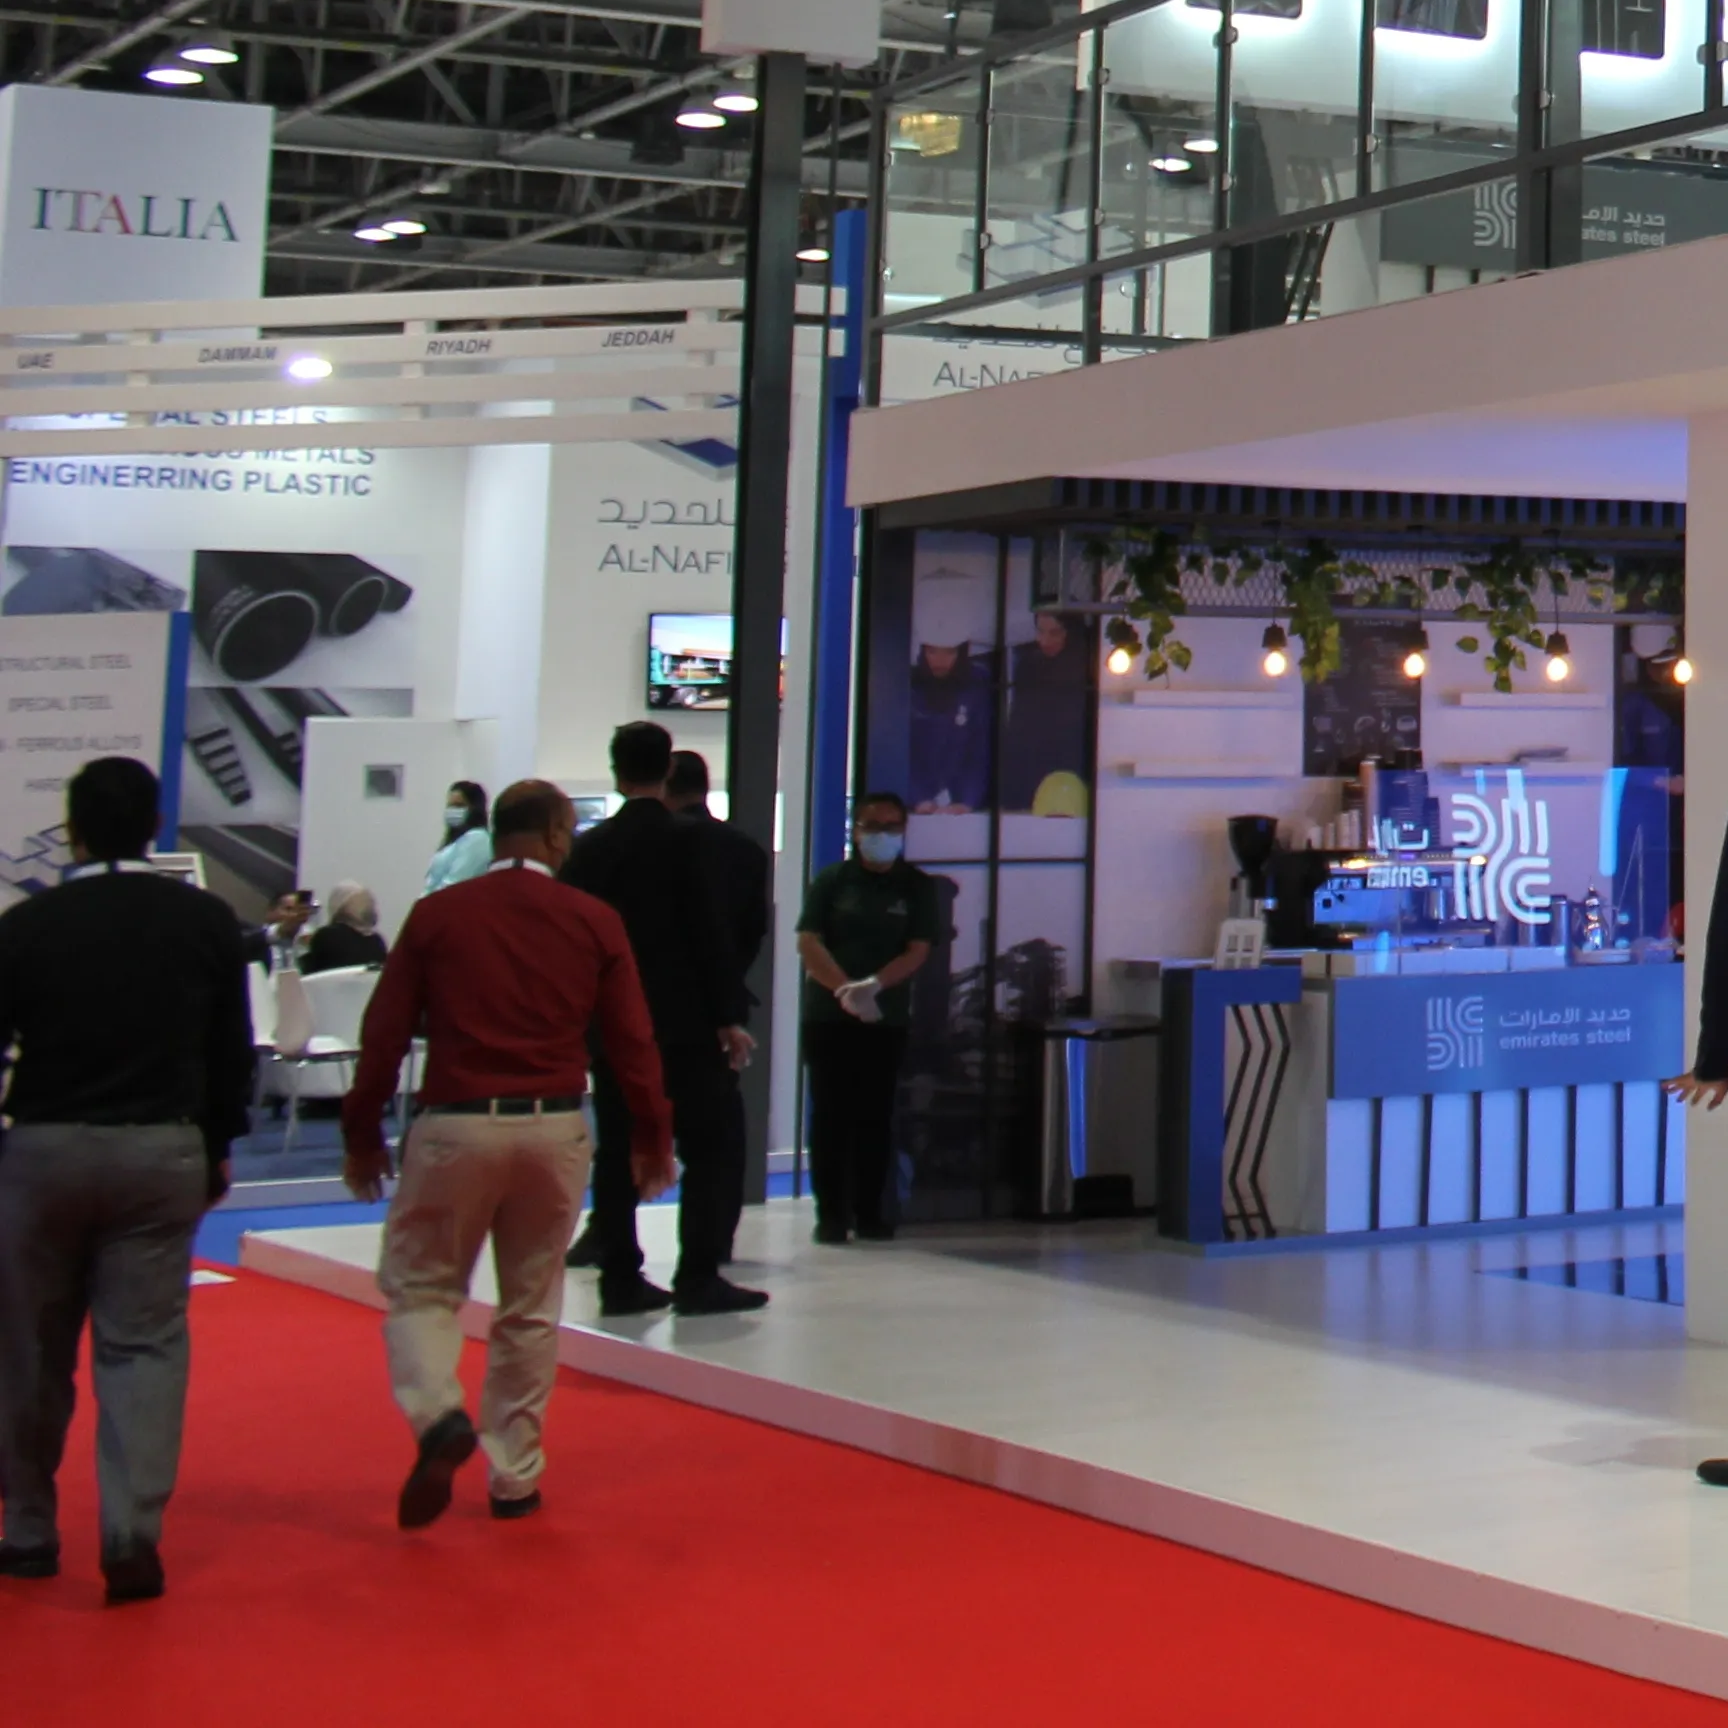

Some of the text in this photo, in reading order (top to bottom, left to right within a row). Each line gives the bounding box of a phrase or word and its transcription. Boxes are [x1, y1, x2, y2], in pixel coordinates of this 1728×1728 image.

[31, 187, 240, 242] ITALIA
[1623, 231, 1665, 246] steel
[426, 339, 491, 355] RIYADH
[601, 329, 675, 348] JEDDAH
[10, 460, 371, 497] ENGINERRING PLASTIC
[1500, 1027, 1631, 1050] emirates steel
